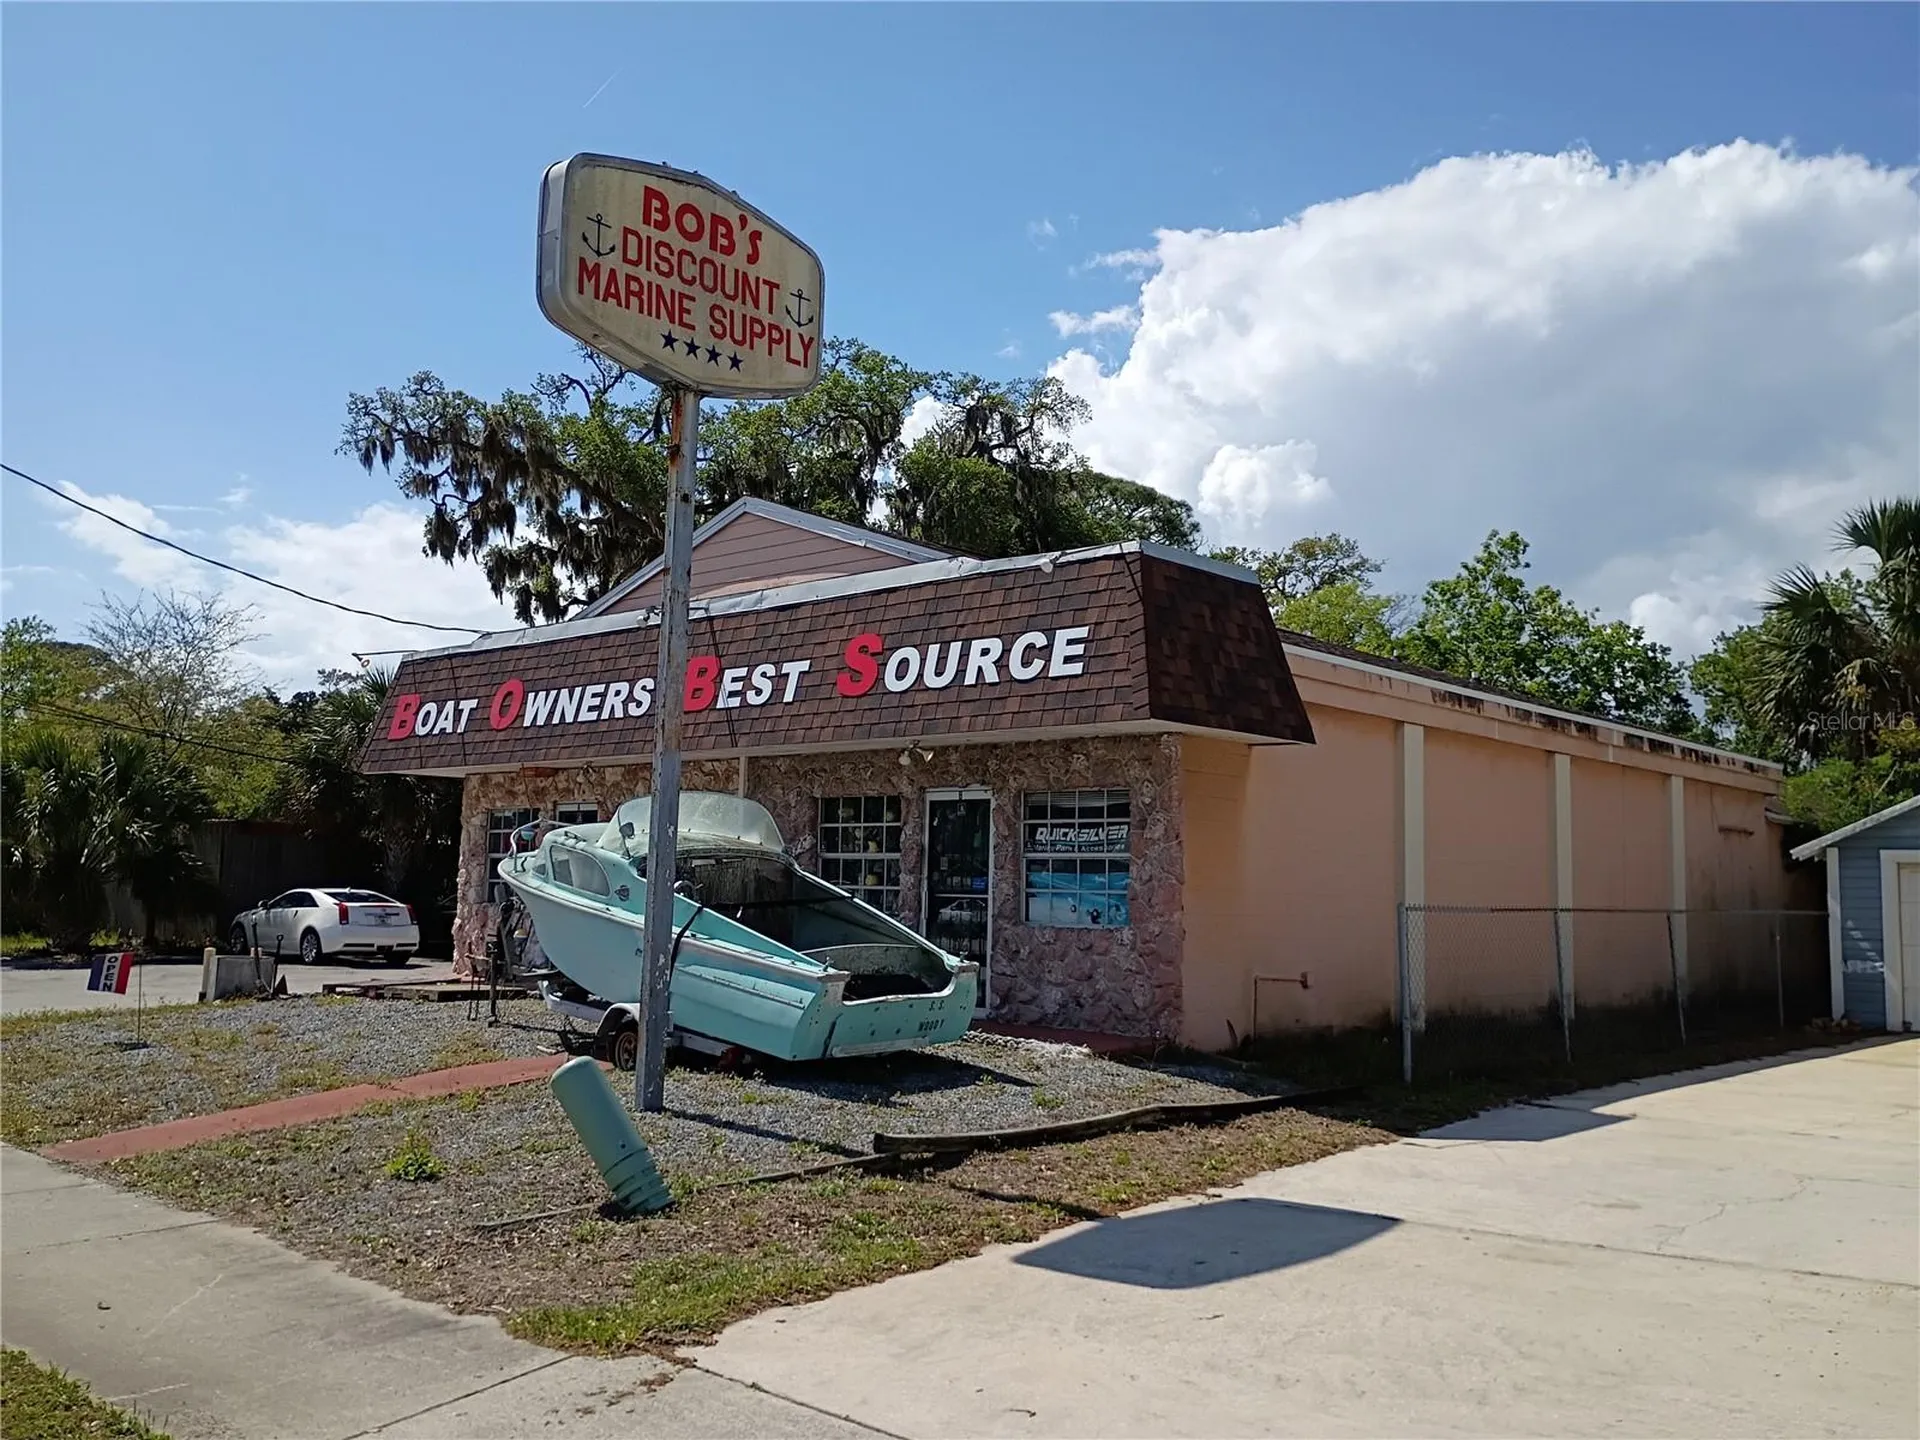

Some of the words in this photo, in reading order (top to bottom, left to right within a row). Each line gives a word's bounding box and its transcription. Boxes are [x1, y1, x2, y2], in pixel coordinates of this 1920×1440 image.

[642, 185, 763, 265] BOB'S
[577, 256, 697, 332] MARINE
[708, 303, 815, 368] SUPPLY
[621, 225, 780, 315] DISCOUNT
[387, 694, 479, 740] BOAT
[489, 677, 655, 731] OWNERS
[683, 655, 811, 713] BEST
[836, 626, 1091, 697] SOURCE
[1035, 825, 1129, 844] QUICKSILVER
[102, 956, 119, 992] OPEN
